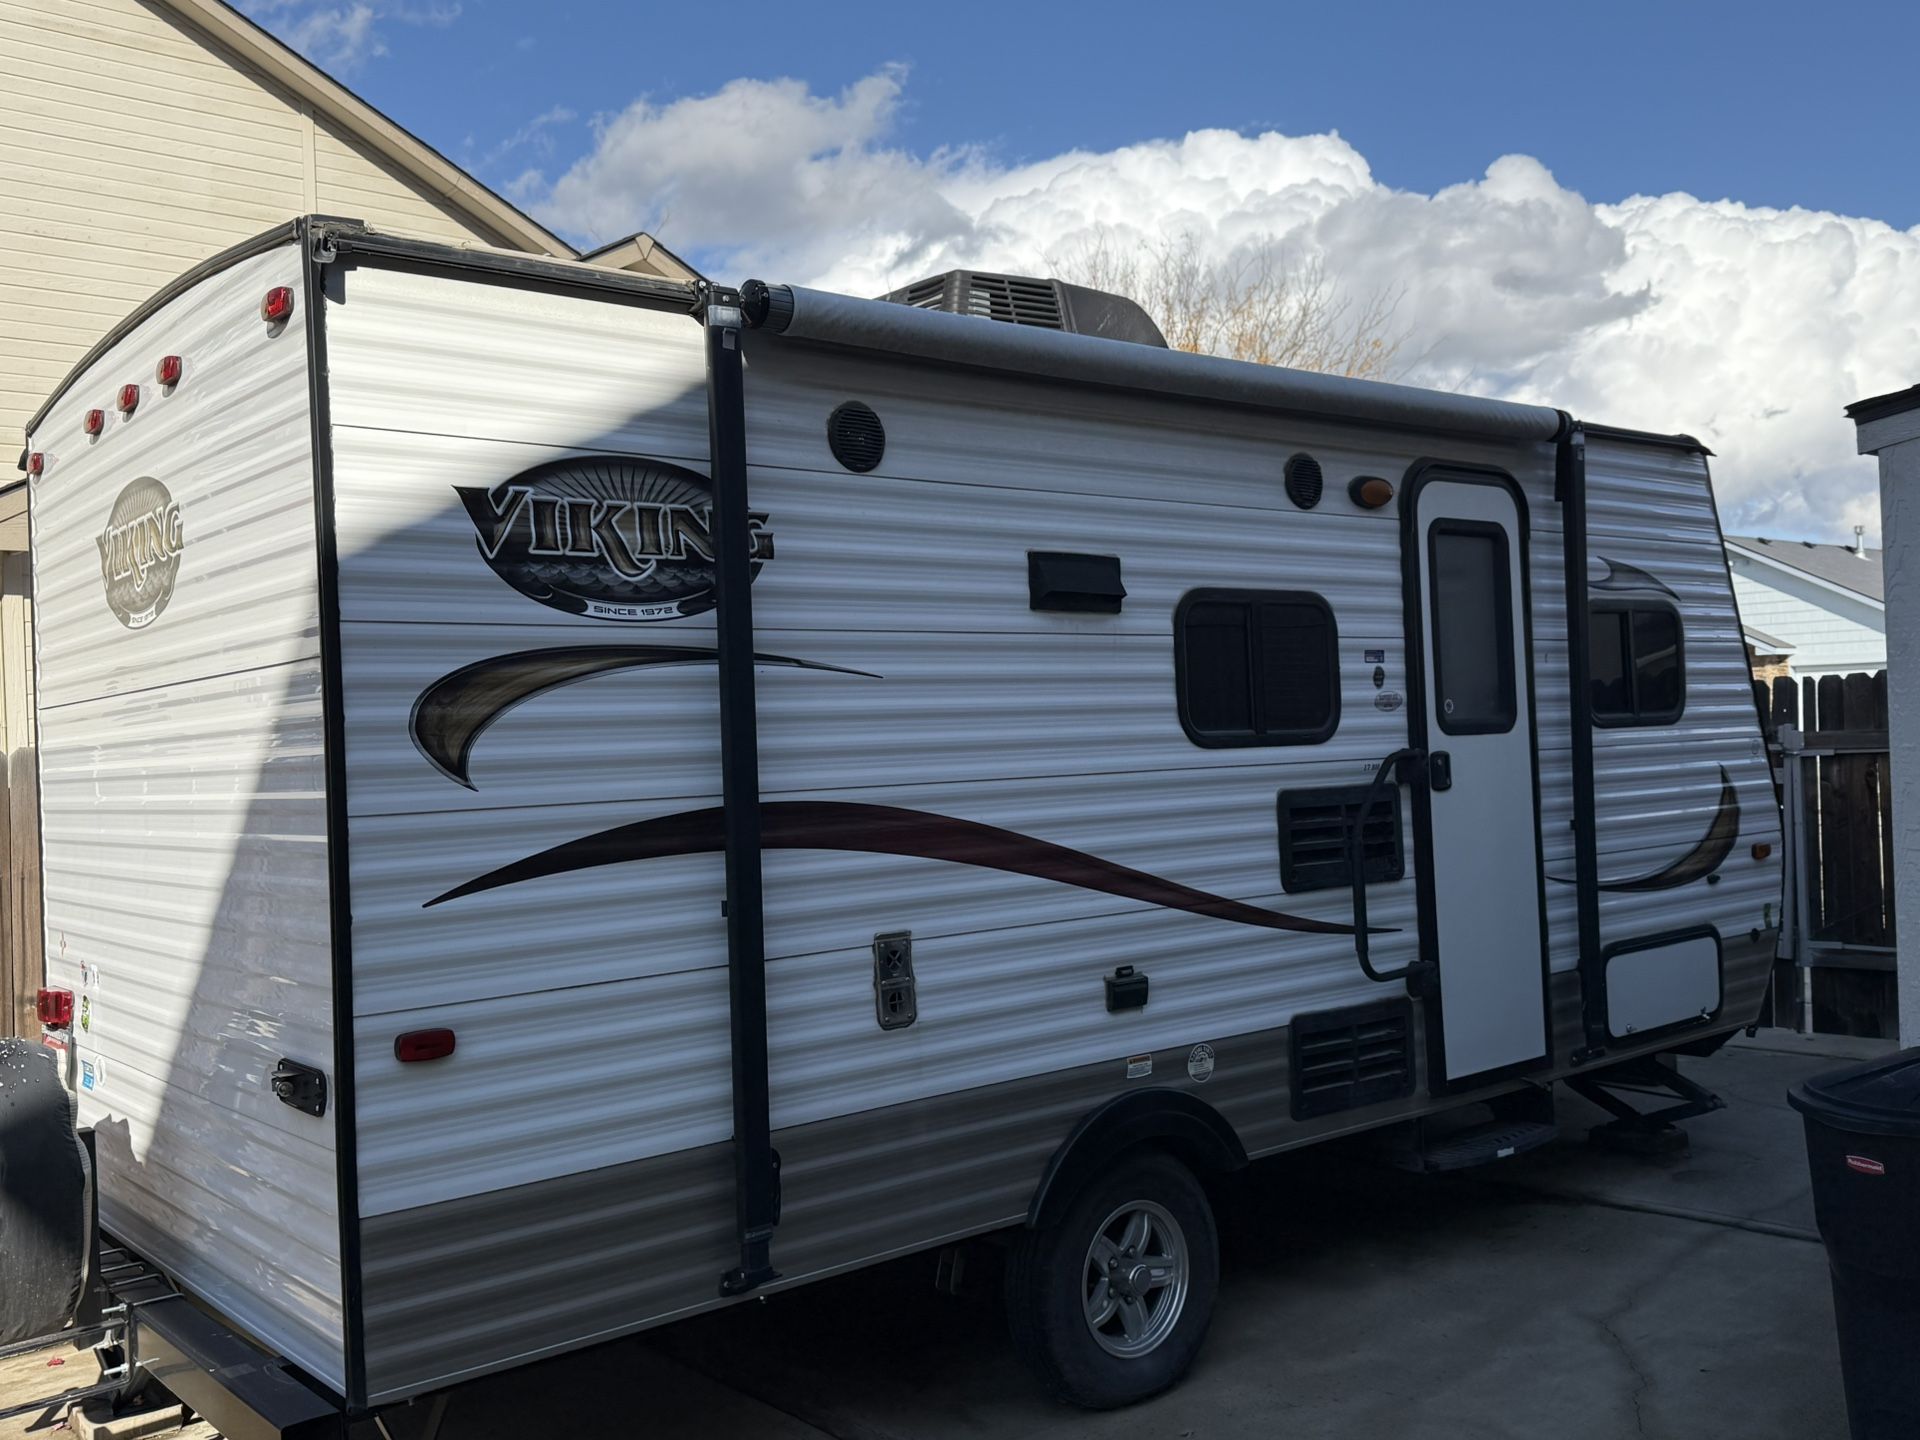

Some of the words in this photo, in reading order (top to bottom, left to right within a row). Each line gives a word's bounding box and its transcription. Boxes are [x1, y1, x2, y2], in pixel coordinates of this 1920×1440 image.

[95, 502, 184, 591] VIKING
[594, 605, 638, 616] SINCE
[641, 606, 674, 616] 1972
